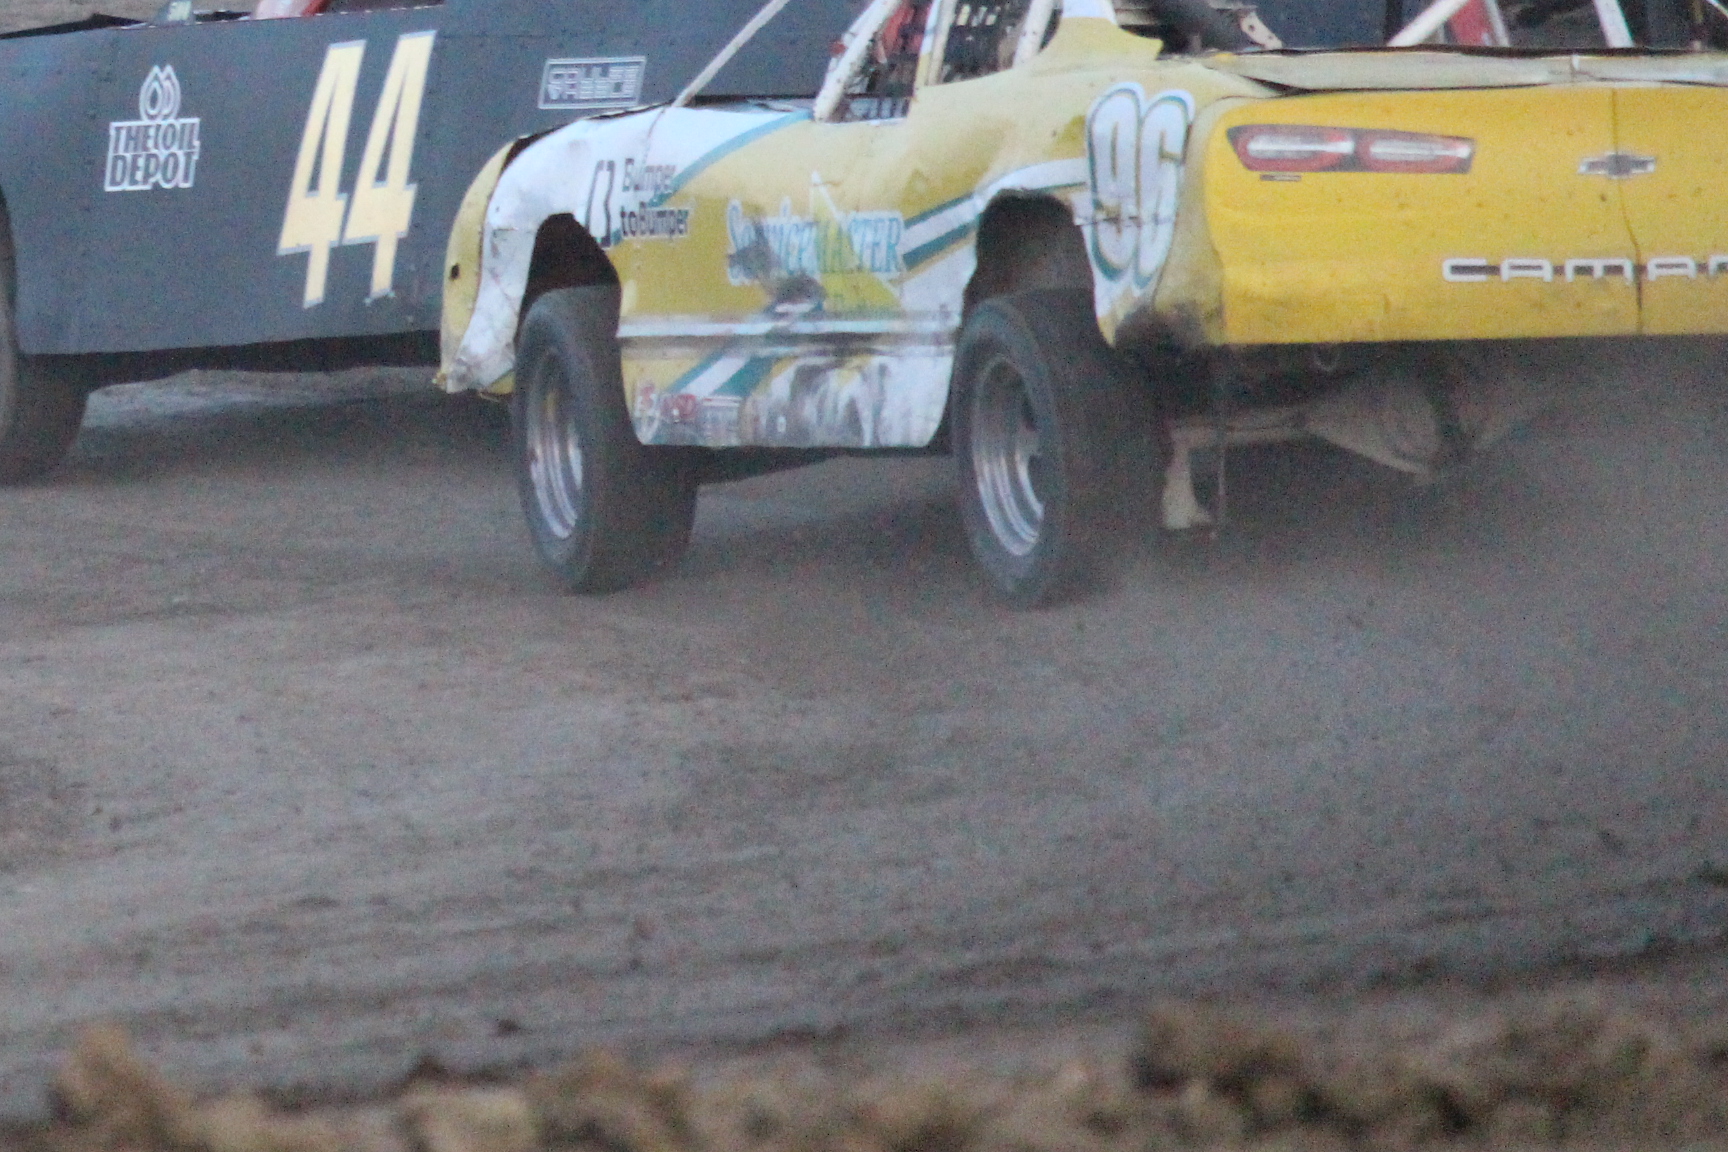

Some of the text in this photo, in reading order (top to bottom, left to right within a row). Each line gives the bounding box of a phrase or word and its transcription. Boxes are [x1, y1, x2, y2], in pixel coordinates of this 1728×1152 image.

[112, 124, 159, 154] THE
[109, 151, 194, 188] DEPOT
[276, 30, 438, 309] 44
